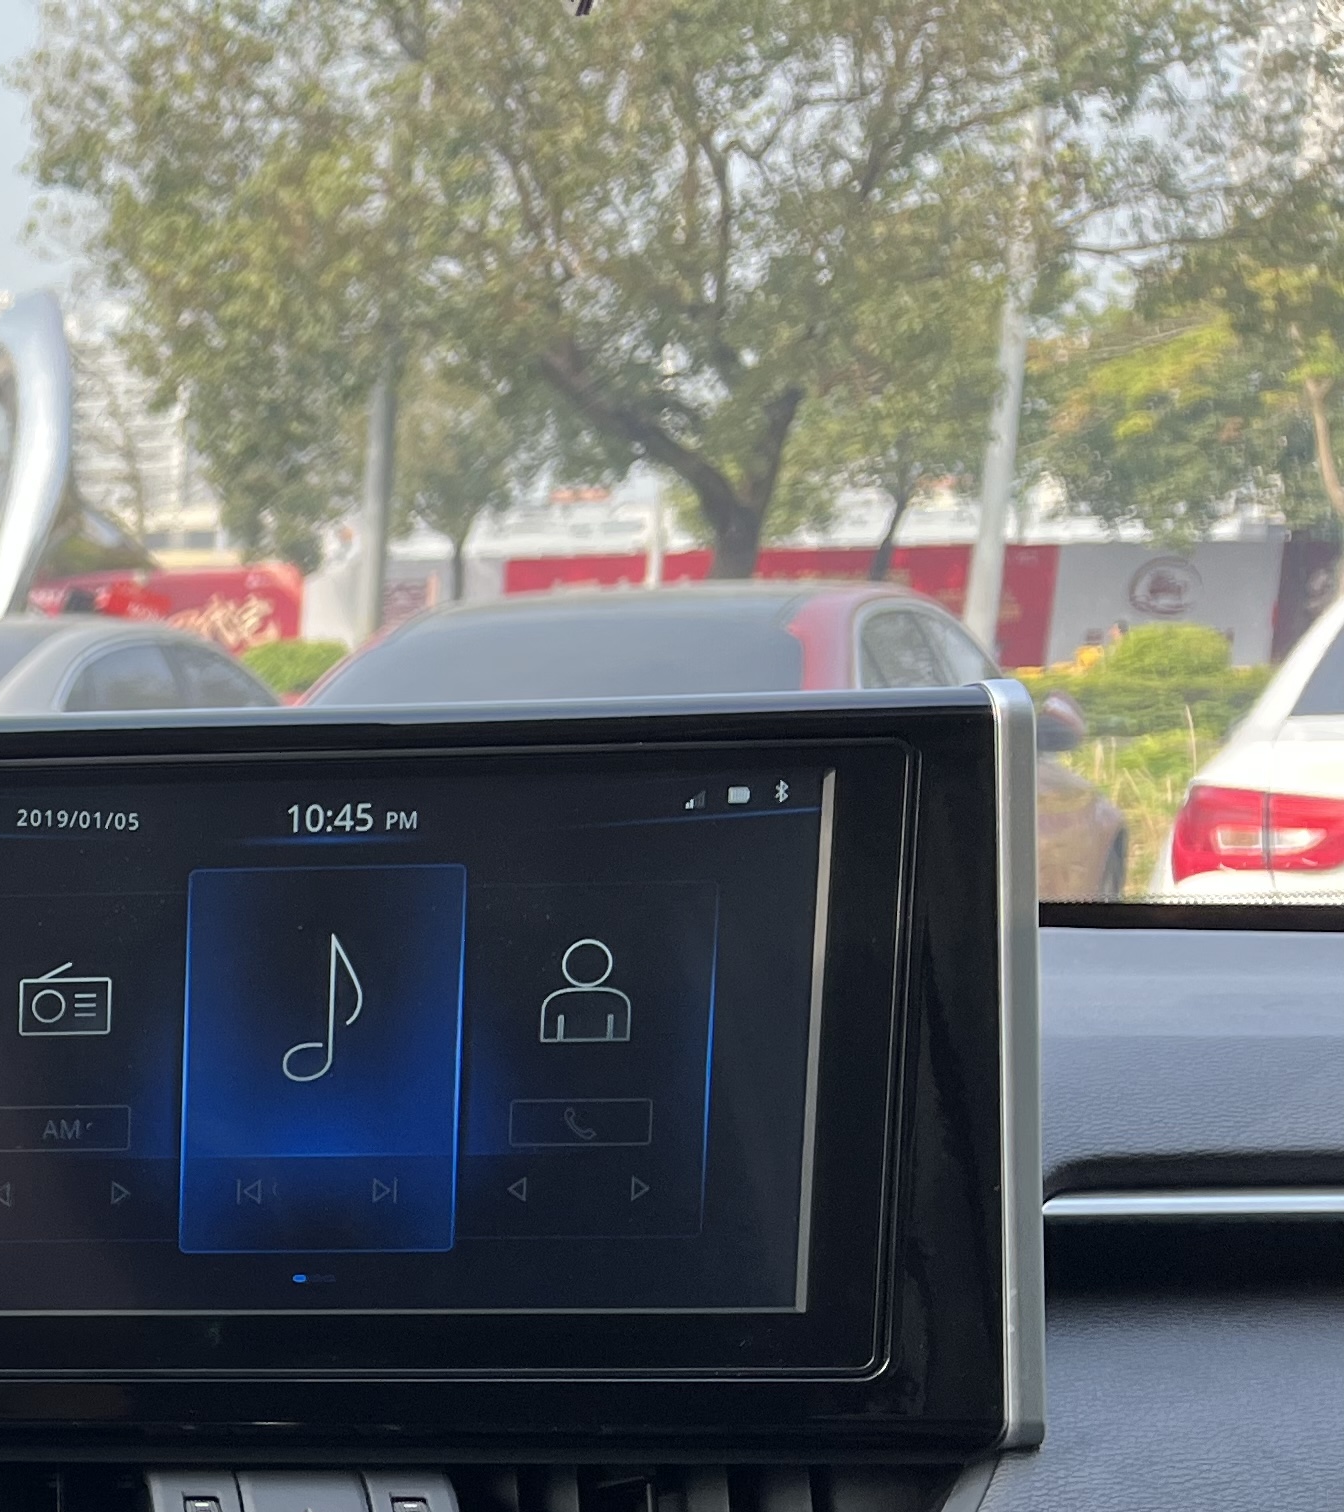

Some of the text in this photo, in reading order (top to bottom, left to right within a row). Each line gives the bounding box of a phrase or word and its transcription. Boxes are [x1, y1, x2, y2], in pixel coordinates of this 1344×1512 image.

[16, 808, 140, 831] 2019/01/05
[286, 803, 419, 833] 10:45 PM
[42, 1118, 81, 1140] AM
